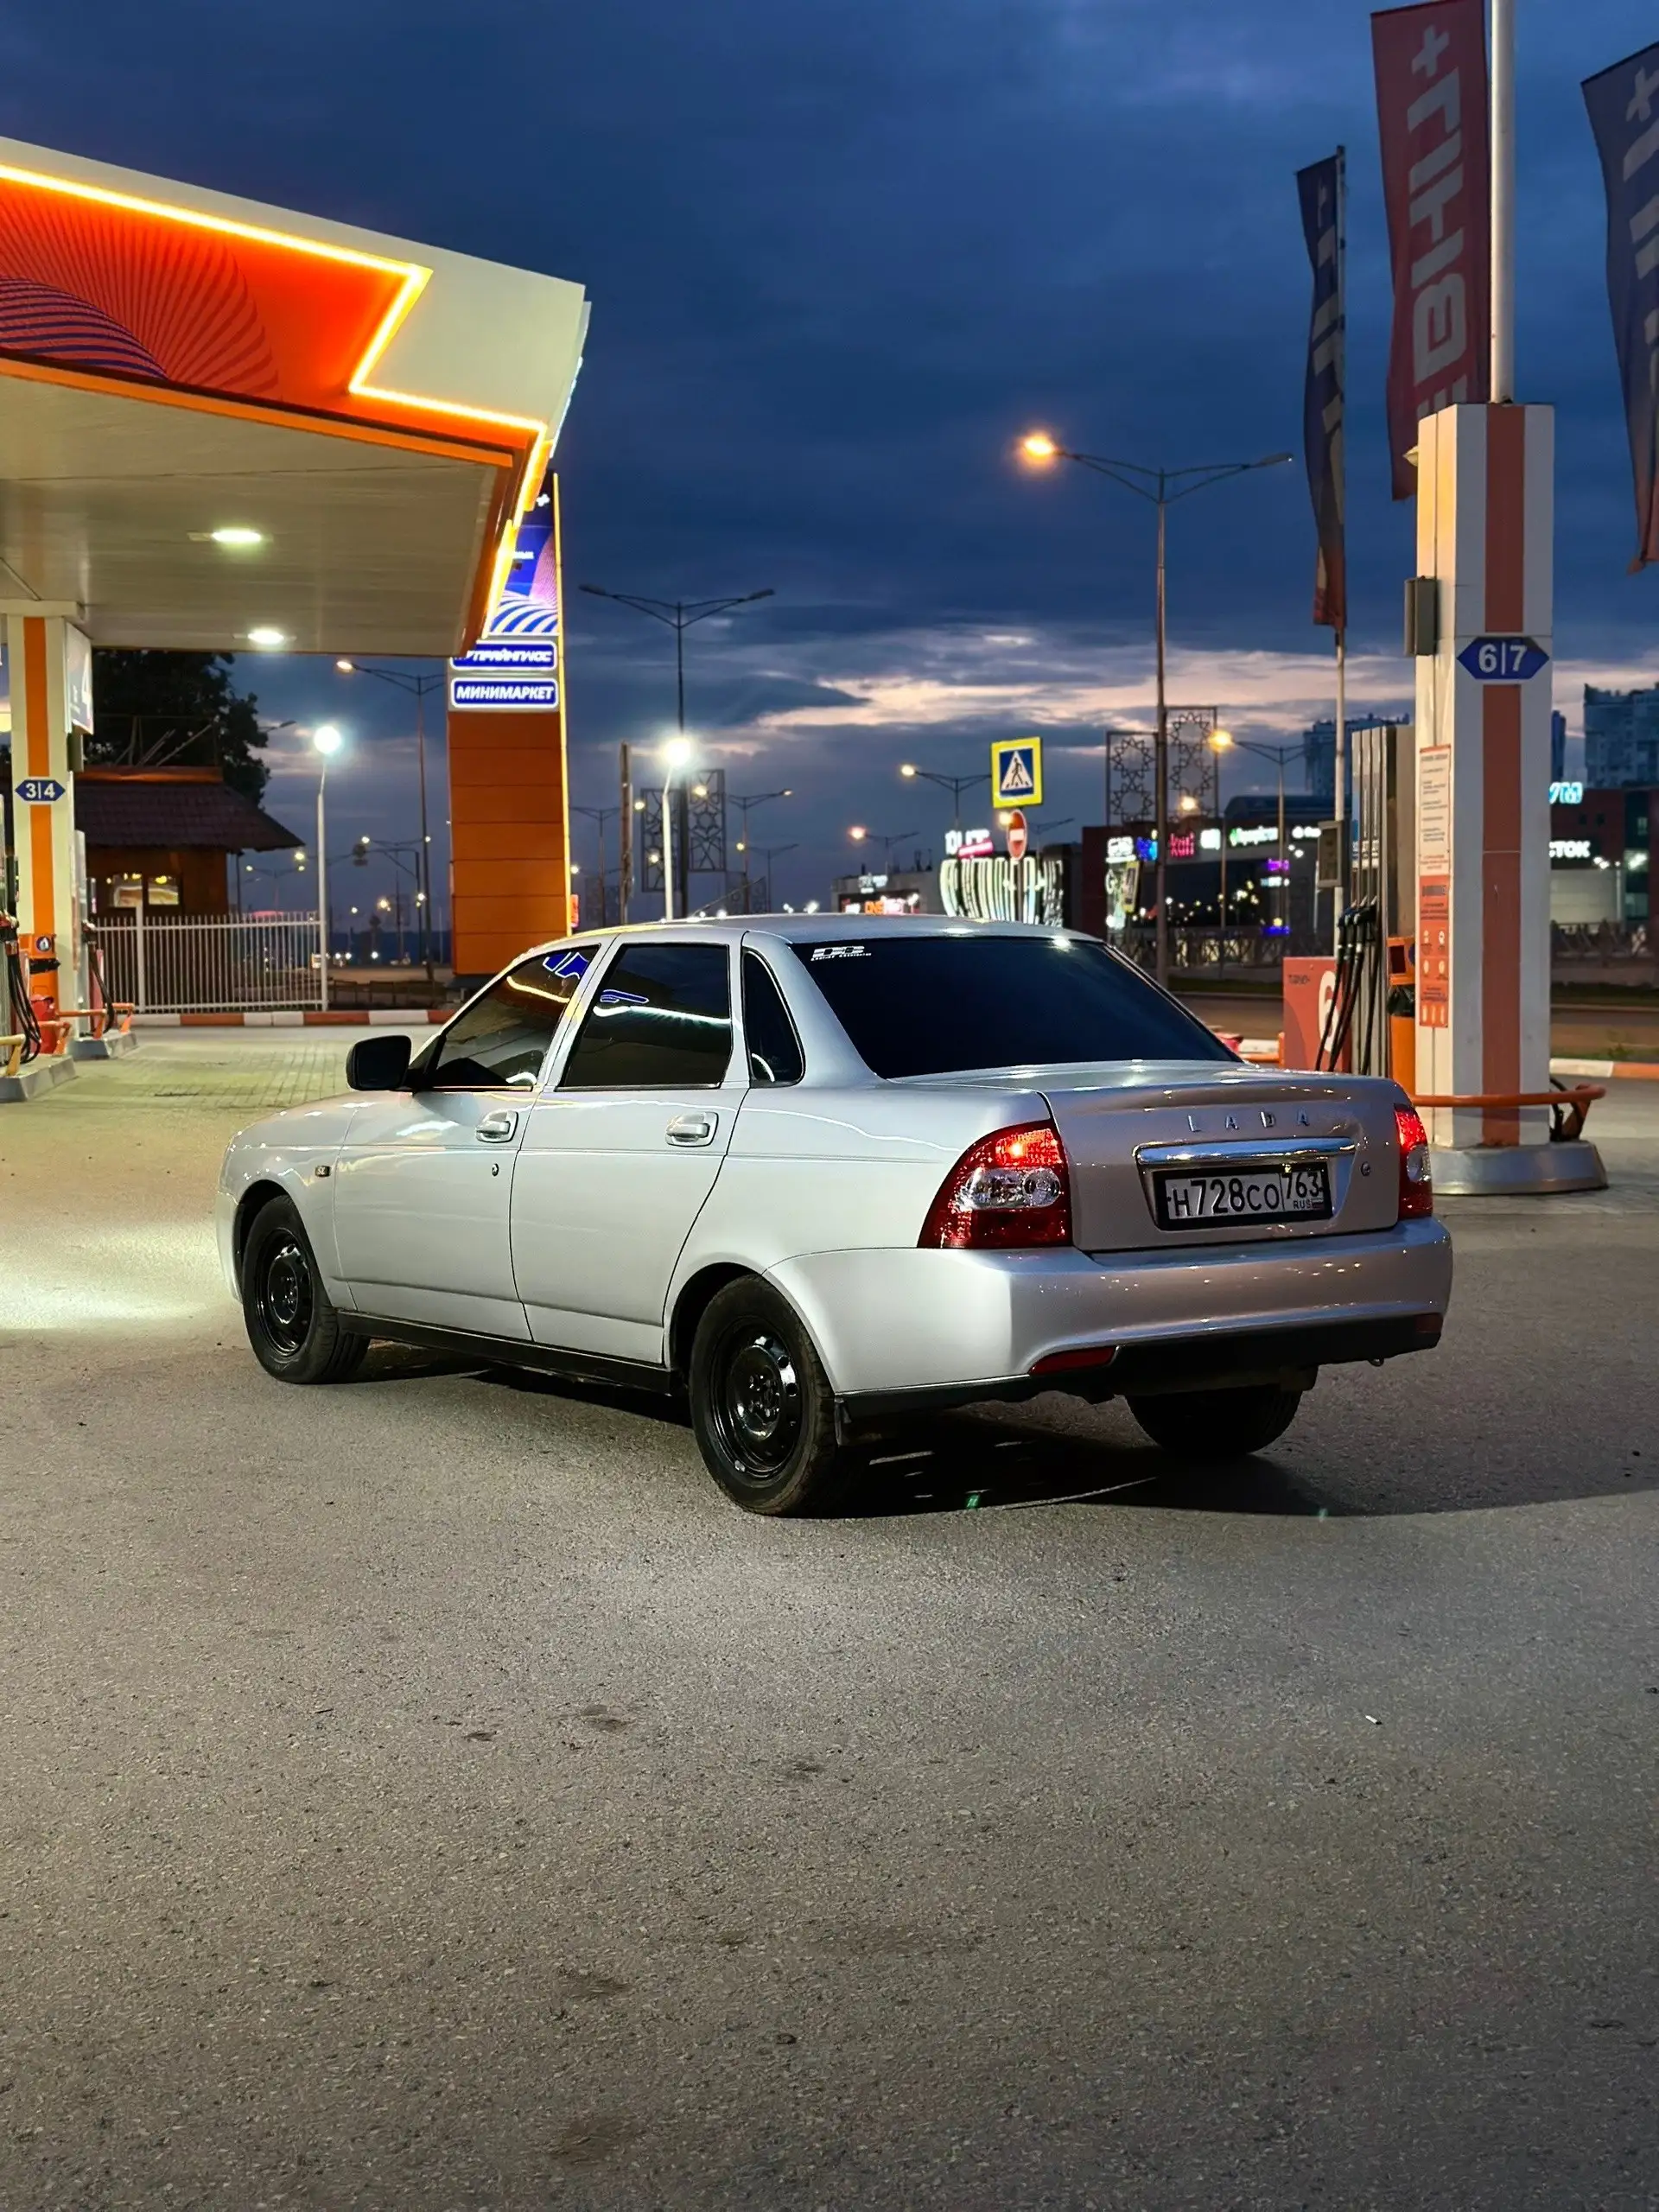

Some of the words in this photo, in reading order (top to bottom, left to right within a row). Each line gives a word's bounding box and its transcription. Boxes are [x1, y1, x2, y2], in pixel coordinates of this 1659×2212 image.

[455, 685, 555, 700] МИНИМАРКЕТ
[1187, 1107, 1310, 1133] LADA
[1281, 1171, 1321, 1200] 763
[1293, 1200, 1312, 1211] RUS
